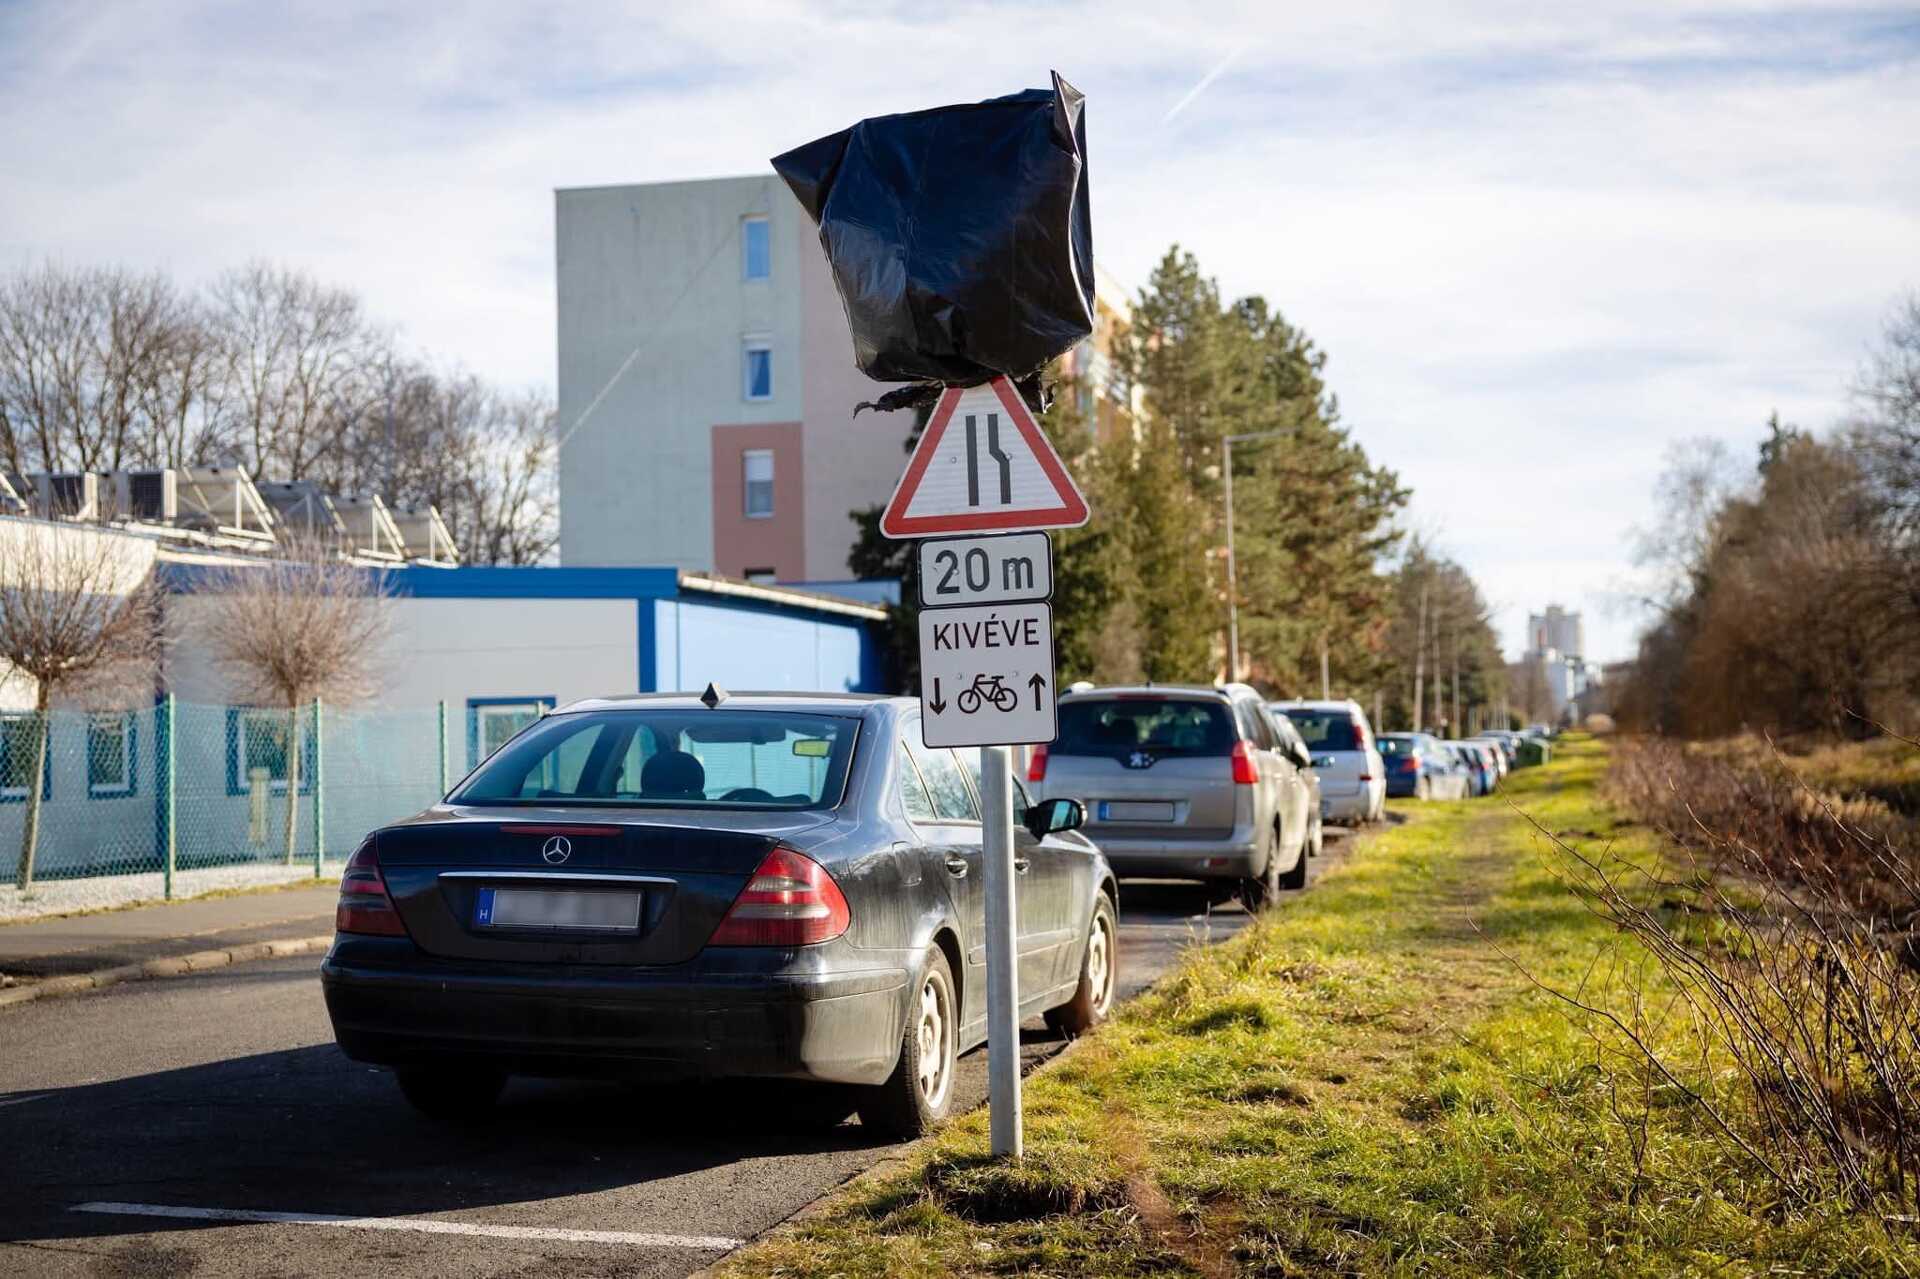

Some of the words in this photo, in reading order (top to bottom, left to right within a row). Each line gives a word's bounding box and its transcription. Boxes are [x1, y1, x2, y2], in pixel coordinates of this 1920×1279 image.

[935, 547, 990, 594] 20
[1002, 556, 1034, 590] m
[933, 613, 1040, 650] KIVÉVE
[480, 908, 488, 920] H
